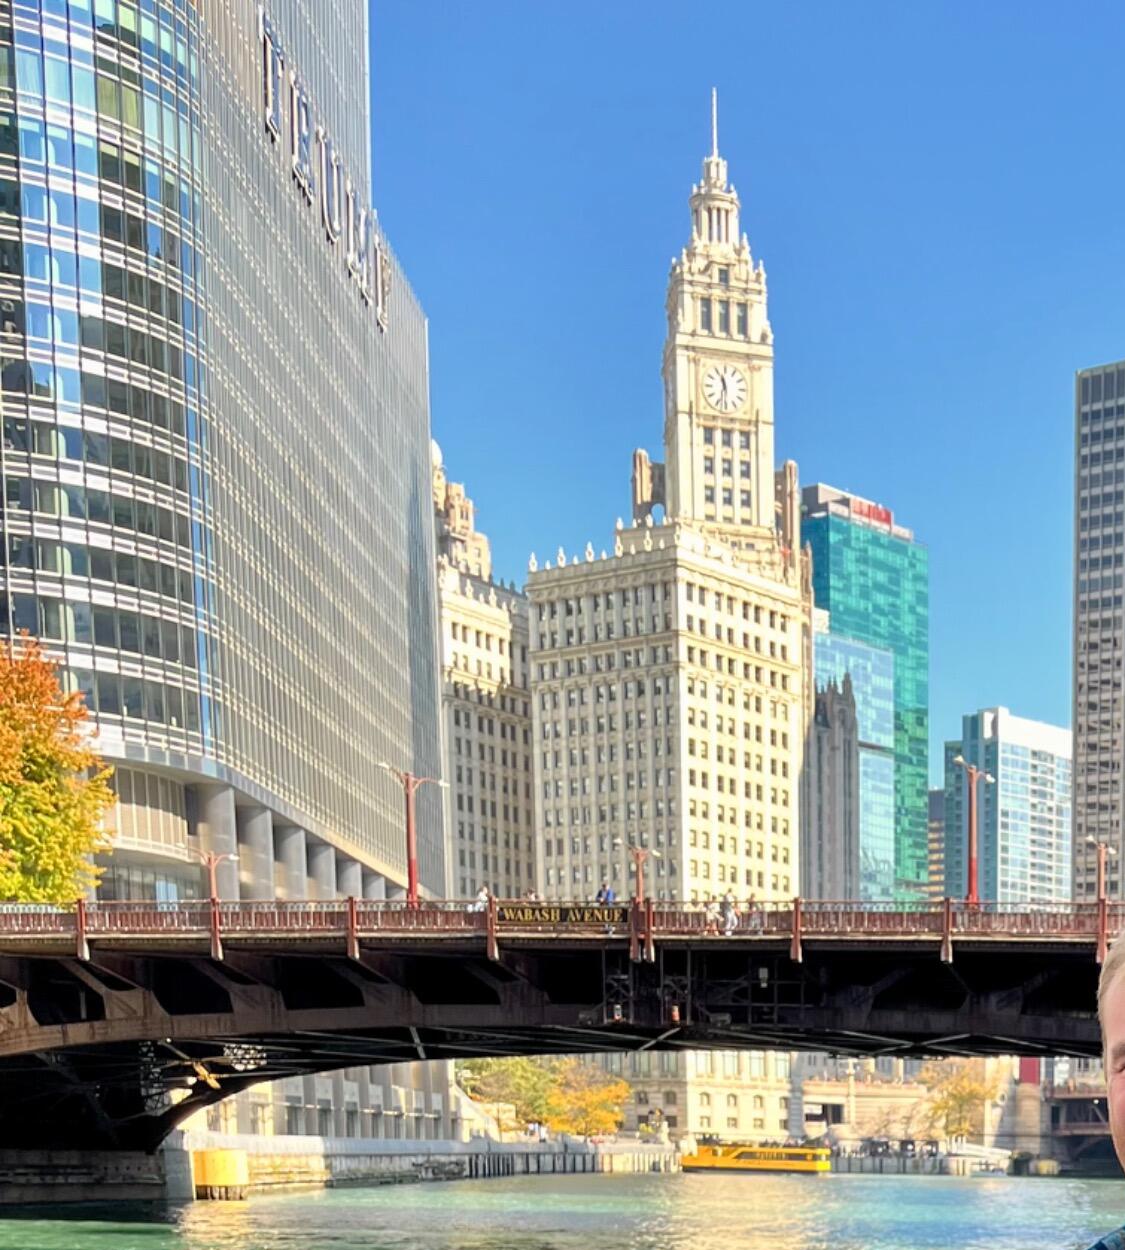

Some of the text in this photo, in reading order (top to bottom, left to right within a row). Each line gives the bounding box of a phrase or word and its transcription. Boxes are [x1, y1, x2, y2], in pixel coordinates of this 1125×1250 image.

[258, 4, 391, 333] TRUMP
[503, 907, 623, 921] WABASH AVENUE
